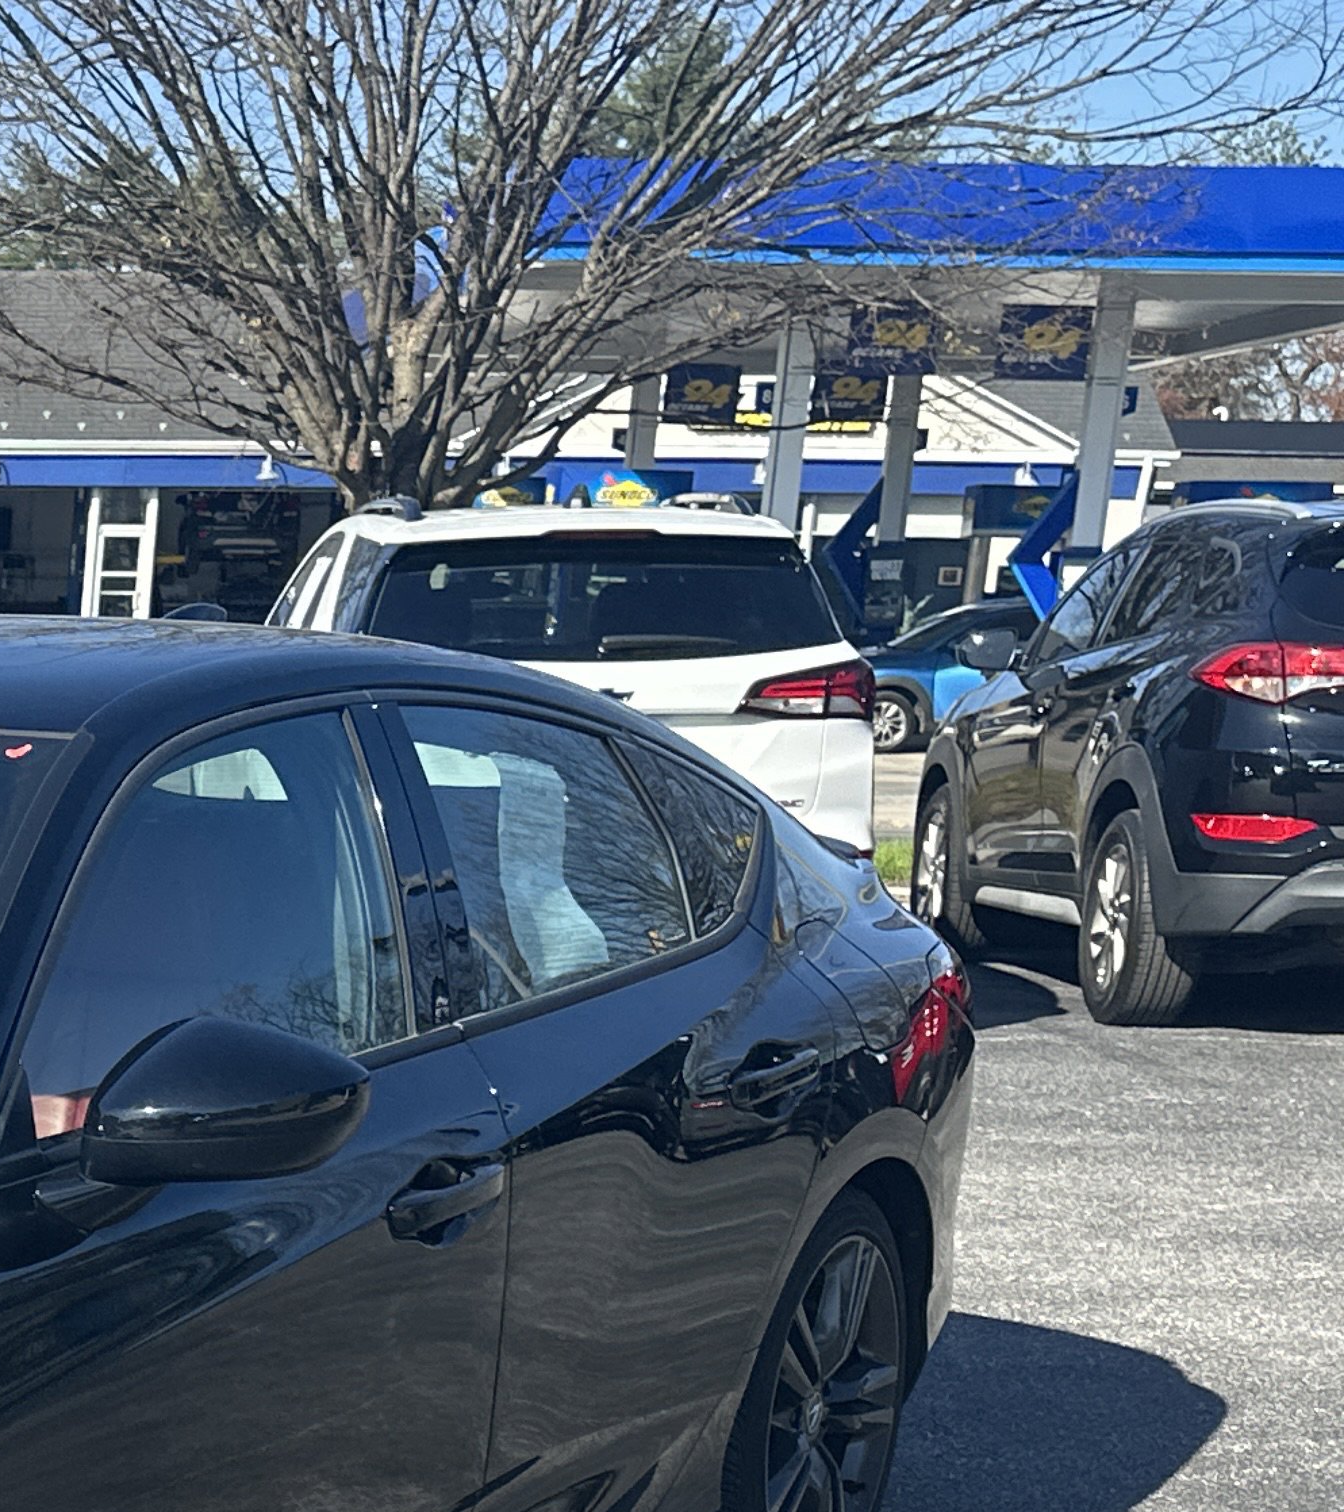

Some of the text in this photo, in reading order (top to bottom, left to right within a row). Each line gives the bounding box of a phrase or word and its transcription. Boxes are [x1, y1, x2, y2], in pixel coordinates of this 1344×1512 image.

[1024, 322, 1081, 359] 94
[683, 378, 733, 409] 94
[831, 376, 881, 405] 94
[599, 489, 657, 501] SUNOCO
